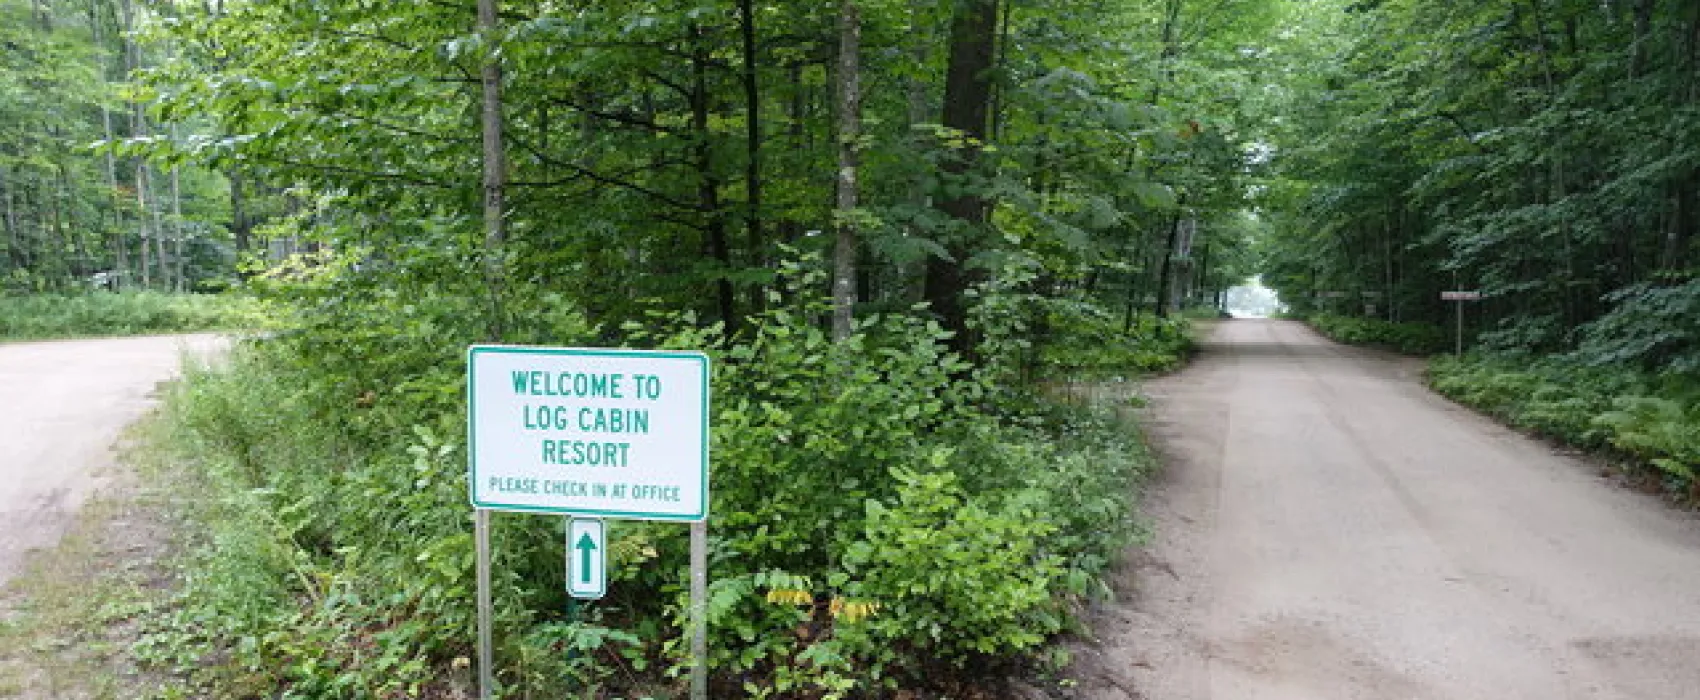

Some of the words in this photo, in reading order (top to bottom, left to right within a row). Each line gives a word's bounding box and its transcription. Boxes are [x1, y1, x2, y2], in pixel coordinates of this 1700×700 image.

[512, 371, 623, 398] WELCOME
[632, 374, 662, 400] TO
[523, 406, 567, 430] LOG
[578, 408, 649, 433] CABIN
[542, 440, 630, 467] RESORT
[489, 477, 538, 494] PLEASE
[544, 480, 588, 497] CHECK
[592, 483, 606, 497] IN
[611, 484, 626, 498] AT
[632, 485, 681, 502] OFFICE
